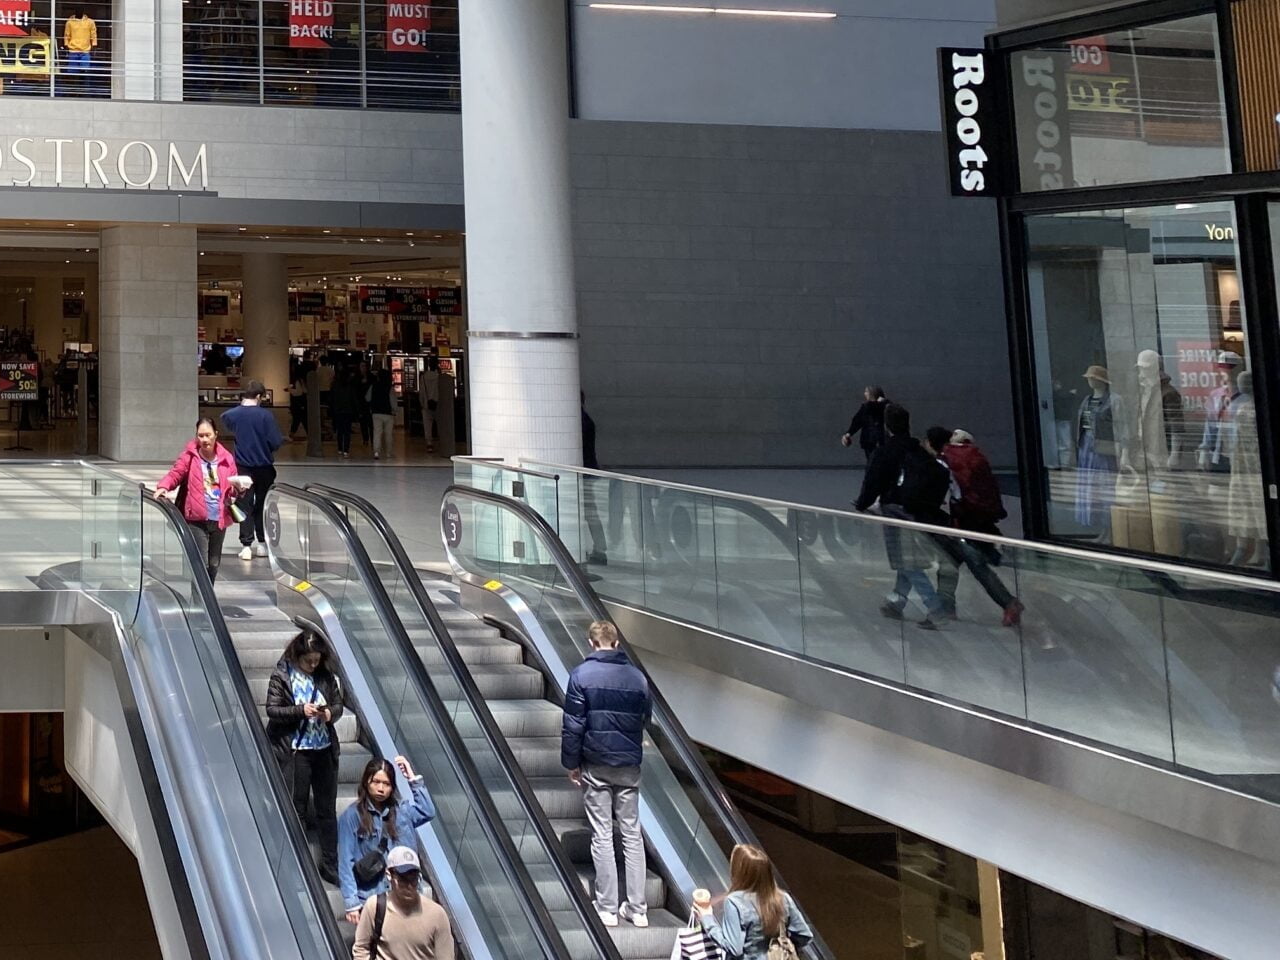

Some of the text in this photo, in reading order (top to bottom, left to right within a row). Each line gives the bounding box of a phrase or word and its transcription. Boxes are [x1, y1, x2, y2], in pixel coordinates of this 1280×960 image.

[291, 0, 333, 17] HELD
[389, 3, 430, 19] MUST
[290, 24, 333, 39] BACK!
[391, 28, 427, 46] GO!
[951, 52, 988, 191] Roots
[1205, 223, 1233, 241] Yon
[9, 371, 25, 380] 30-
[0, 392, 37, 400] STOREWIDE!
[447, 511, 459, 522] Level
[271, 521, 278, 540] 3
[450, 522, 457, 541] 3
